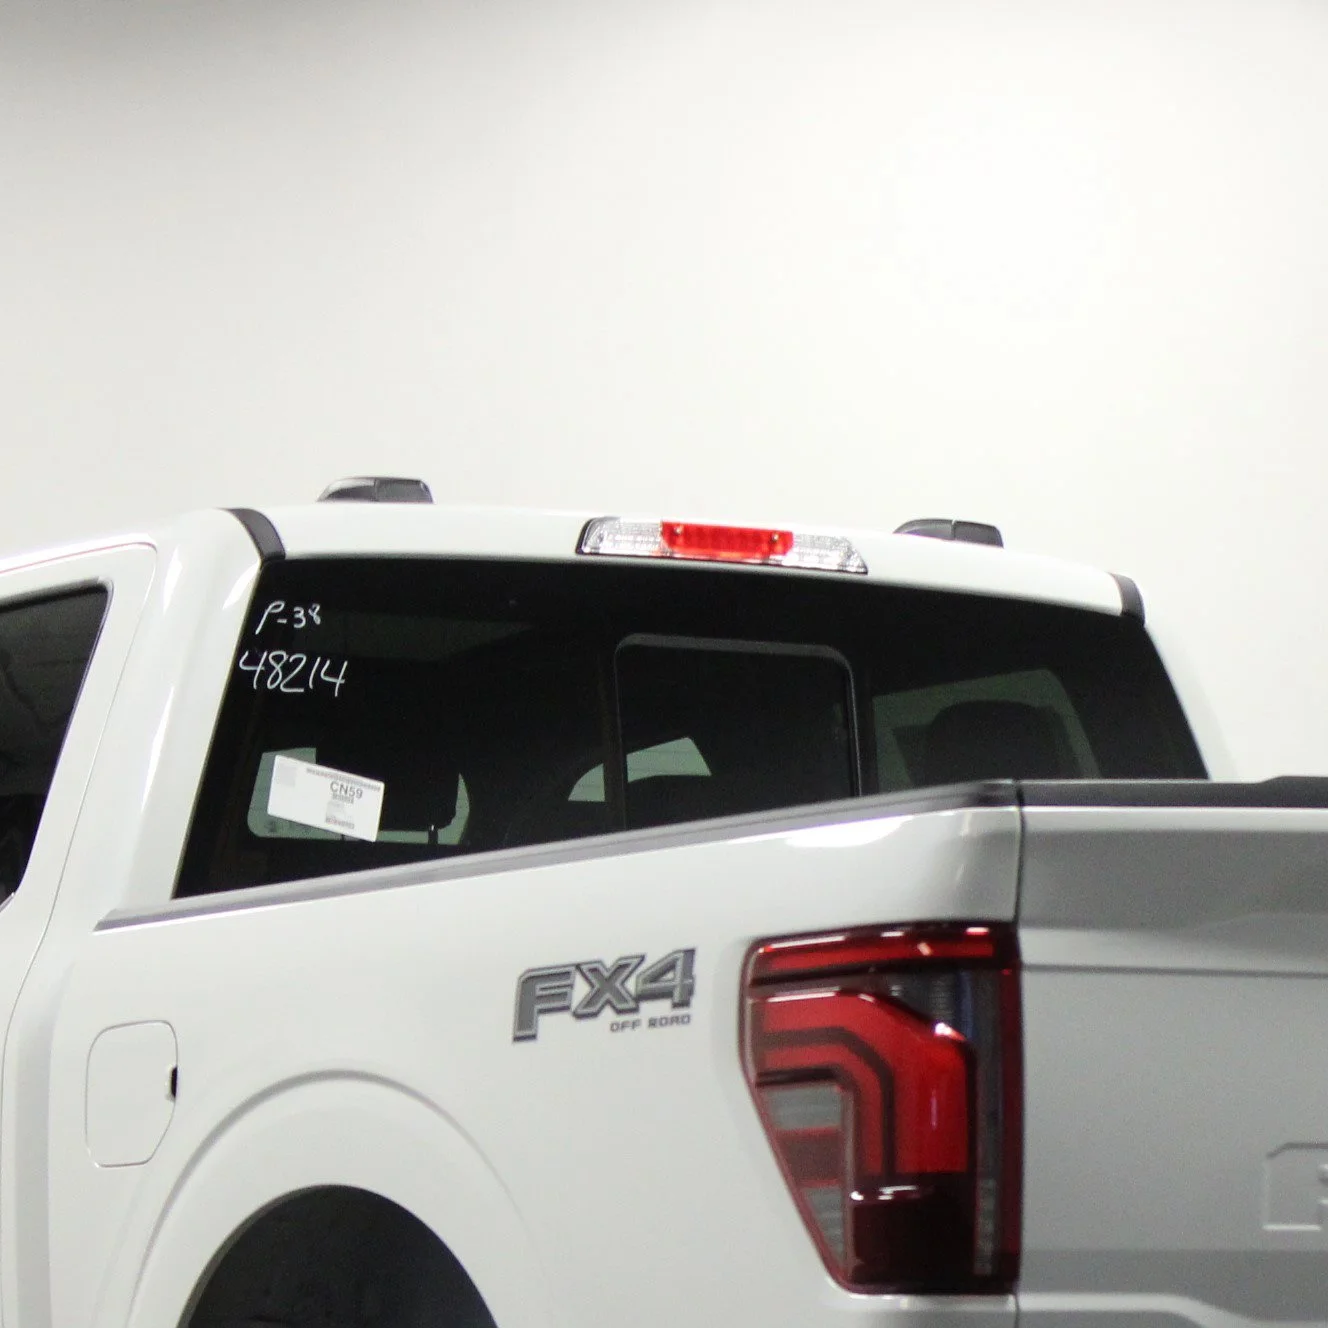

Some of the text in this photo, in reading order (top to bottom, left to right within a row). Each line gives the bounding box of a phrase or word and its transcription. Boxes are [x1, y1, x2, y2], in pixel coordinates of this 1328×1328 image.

[255, 600, 321, 635] P-38
[238, 650, 348, 697] 48214
[329, 780, 364, 799] CN59
[512, 947, 697, 1043] FX4
[609, 1013, 692, 1033] OFF ROAD
